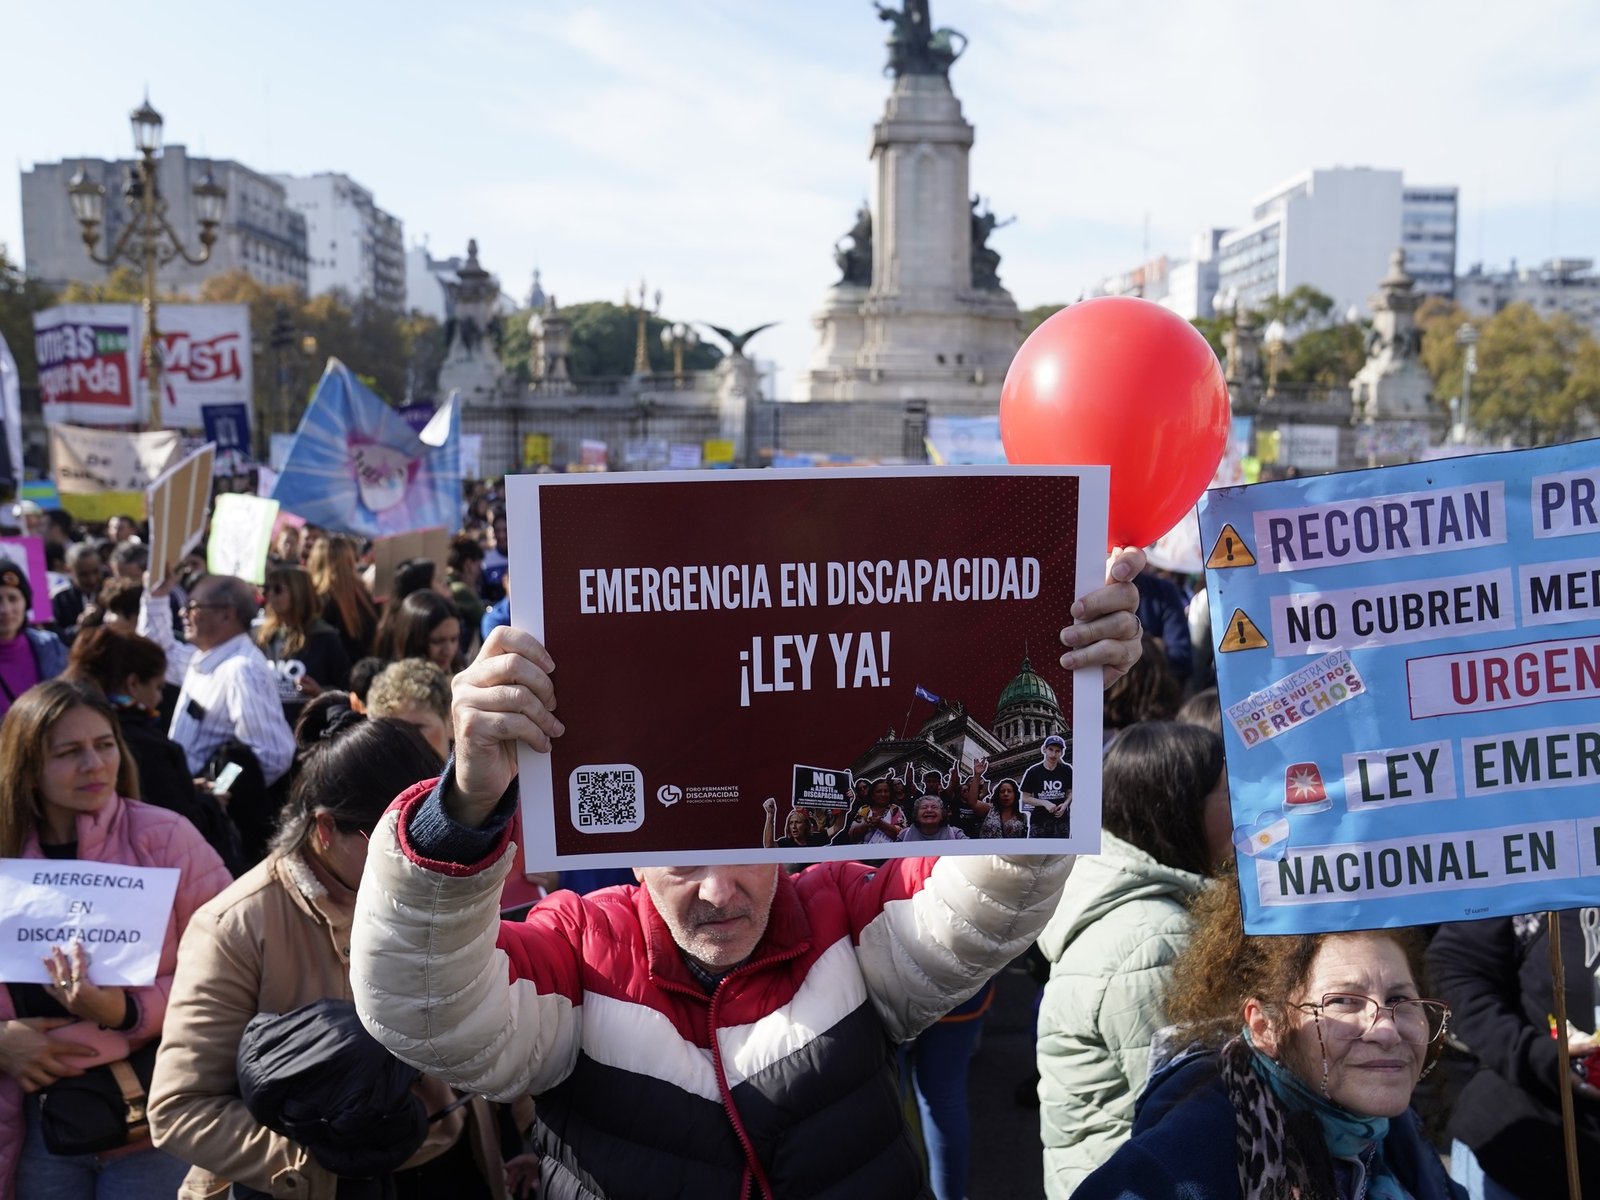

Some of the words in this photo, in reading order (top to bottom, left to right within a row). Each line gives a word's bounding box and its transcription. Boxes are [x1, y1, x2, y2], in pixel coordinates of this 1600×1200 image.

[1269, 490, 1491, 565] RECORTAN
[1542, 477, 1598, 531] PR
[579, 564, 772, 614] EMERGENCIA
[780, 562, 817, 608] EN
[827, 557, 1041, 606] DISCAPACIDAD
[1286, 603, 1337, 644] NO
[1352, 582, 1500, 637] CUBREN
[739, 633, 819, 707] ¡LEY
[828, 631, 891, 689] YA!
[1229, 689, 1277, 719] ESCUCHA
[1277, 663, 1323, 696] NUESTRA
[1321, 650, 1347, 670] VOZ
[1236, 697, 1290, 729] PROTEGE
[1289, 662, 1352, 702] NUESTROS
[1451, 644, 1600, 706] URGEN
[1242, 674, 1362, 745] DERECHOS
[804, 790, 844, 800] DISCAPACIDAD
[812, 771, 836, 786] NO
[1043, 780, 1062, 791] NO
[1358, 748, 1440, 803] LEY
[1474, 732, 1600, 789] EMER
[32, 872, 144, 890] EMERGENCIA
[1278, 840, 1489, 896] NACIONAL
[1503, 830, 1556, 875] EN
[17, 928, 141, 944] DISCAPACIDAD
[69, 901, 93, 914] EN
